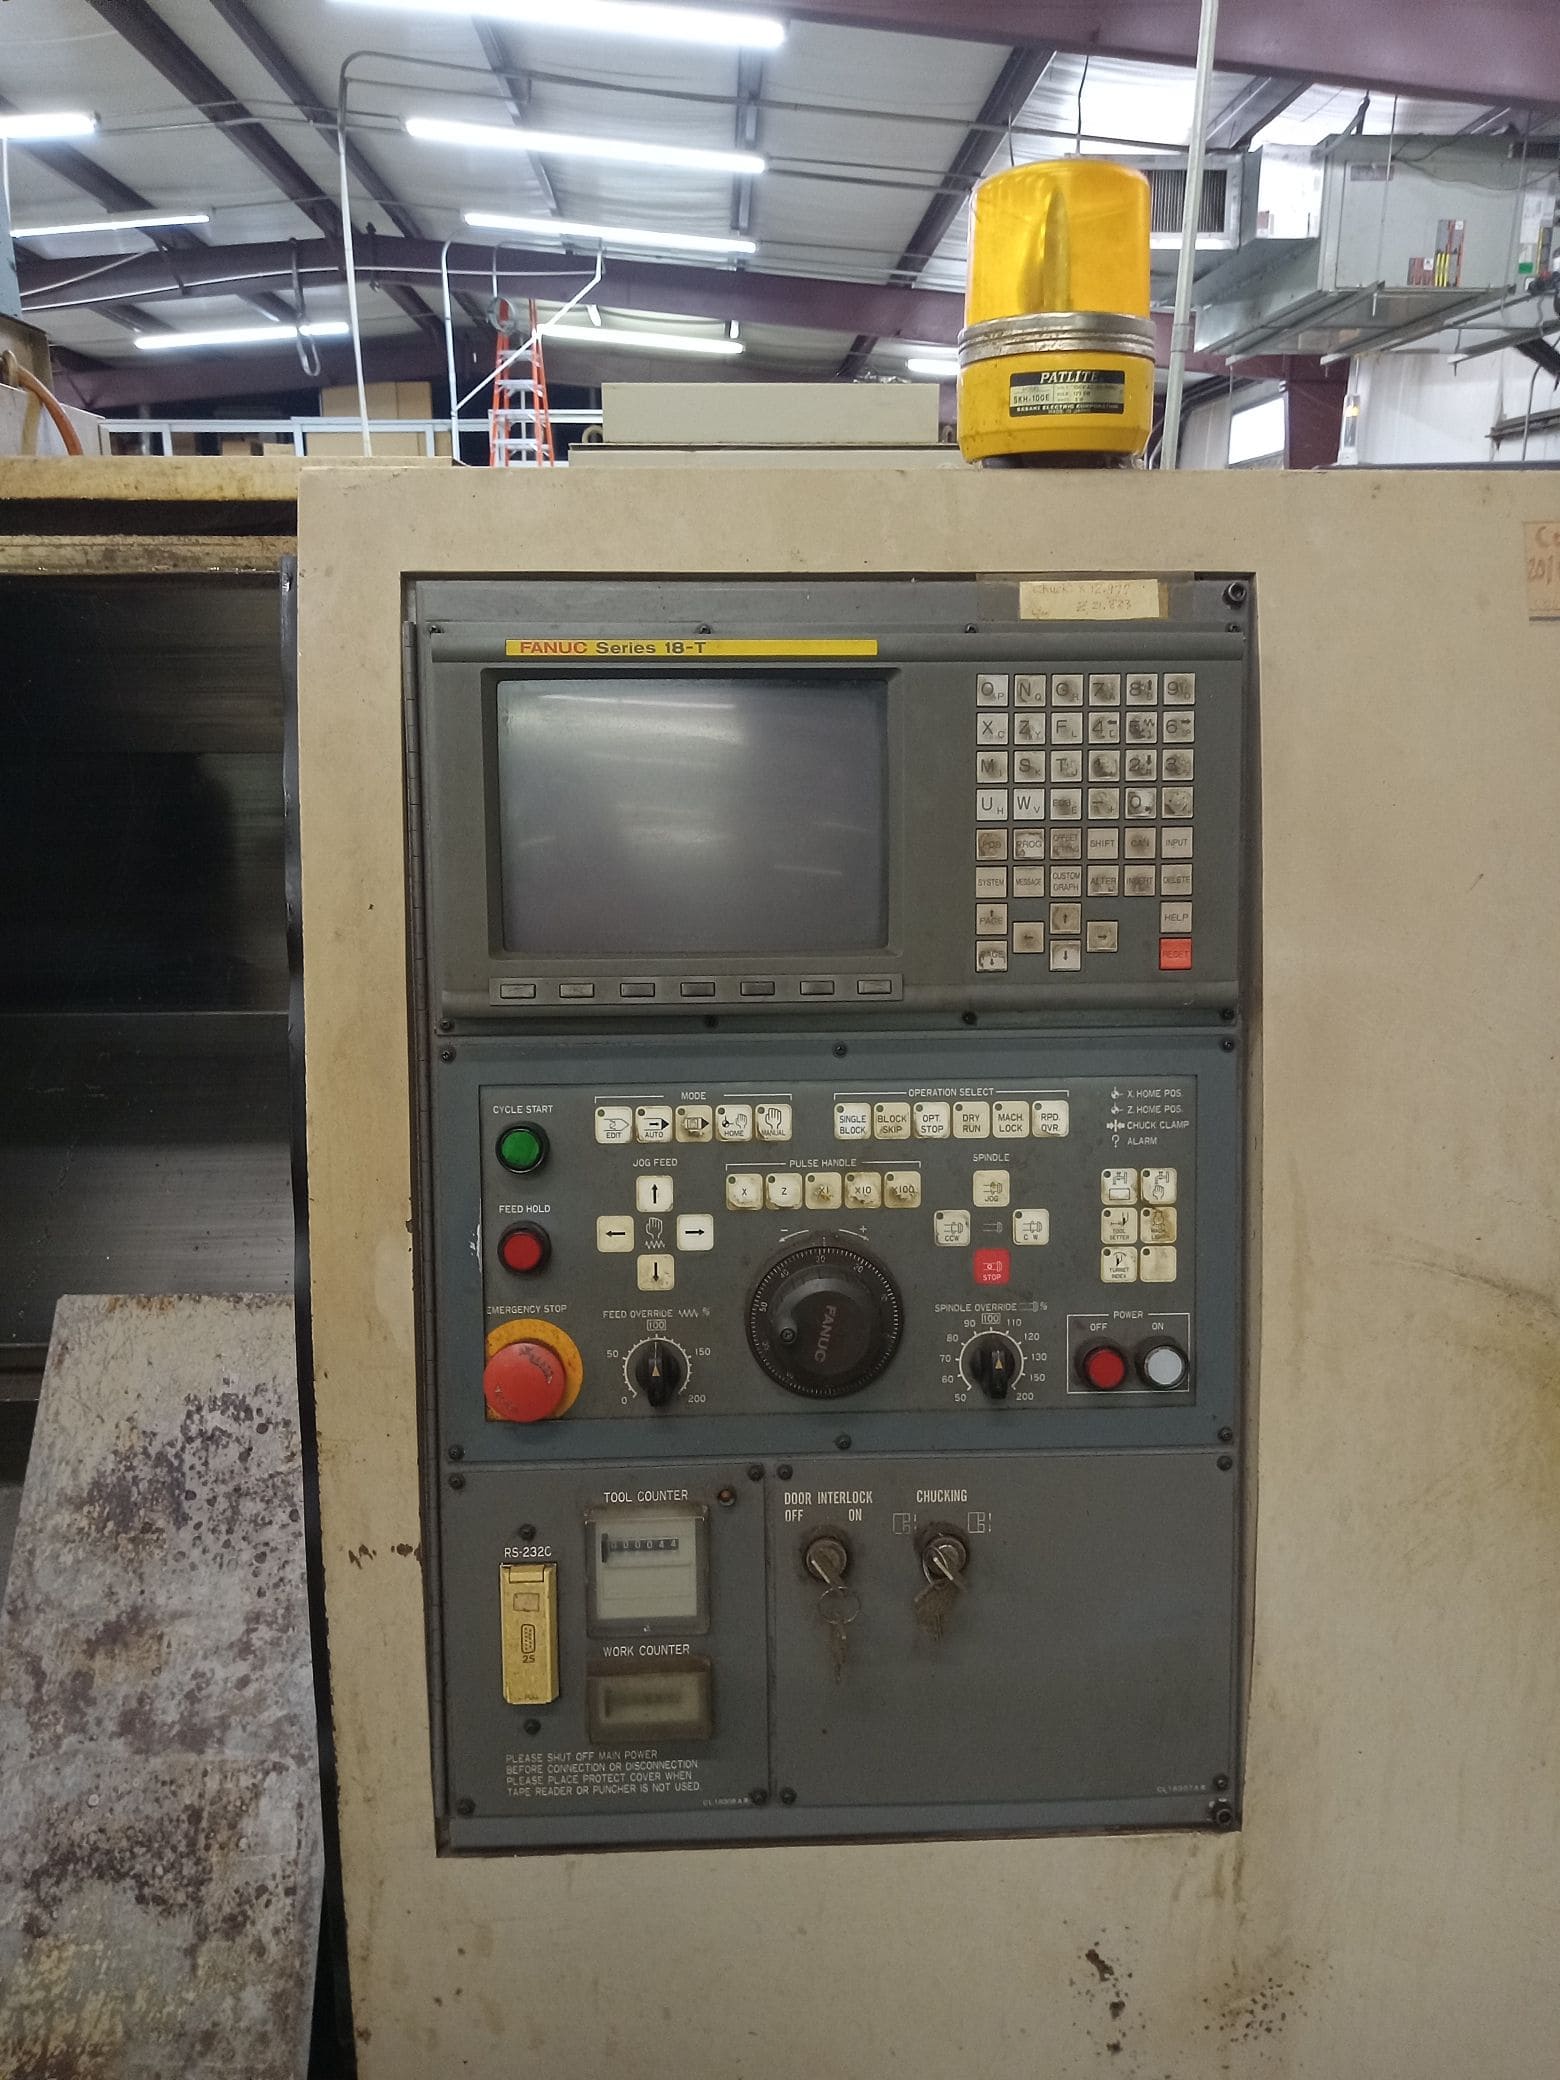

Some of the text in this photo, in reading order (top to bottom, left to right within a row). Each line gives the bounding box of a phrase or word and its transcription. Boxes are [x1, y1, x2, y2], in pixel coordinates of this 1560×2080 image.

[1040, 371, 1098, 383] PATLITE
[520, 641, 707, 654] FANUC Series 18-T
[1020, 682, 1031, 696] N
[1092, 682, 1104, 696] 7
[1129, 681, 1141, 696] 8
[1167, 681, 1178, 695] 9
[983, 721, 993, 735] X
[1020, 720, 1029, 734] Z
[1056, 720, 1067, 733] F
[1092, 720, 1103, 734] 4
[1166, 720, 1177, 733] 6
[1020, 758, 1030, 772] S
[1056, 758, 1067, 772] T
[982, 797, 992, 811] U
[1017, 796, 1031, 810] W
[1016, 840, 1042, 848] PROG
[1090, 840, 1115, 848] SHIFT
[1165, 838, 1188, 847] INPUT
[1052, 872, 1080, 880] CUSTOM
[1163, 876, 1190, 884] DELETE
[1090, 877, 1116, 885] ALTER
[681, 1091, 706, 1100] MODE
[908, 1088, 994, 1097] OPERATION SELECT
[1137, 1089, 1161, 1098] HOME
[493, 1105, 553, 1114] CYCLE START
[1137, 1105, 1161, 1113] HOME
[840, 1115, 866, 1124] SINGLE
[877, 1114, 907, 1123] BLOCK
[962, 1114, 980, 1122] DRY
[883, 1124, 902, 1133] SKIP
[921, 1124, 944, 1133] STOP
[963, 1124, 981, 1132] RUN
[1000, 1124, 1023, 1132] LOCK
[1127, 1121, 1189, 1129] CHUCK CLAMP
[840, 1126, 866, 1134] BLOCK
[1128, 1137, 1157, 1145] ALARM
[972, 1153, 1010, 1162] SPINDLE
[633, 1158, 678, 1167] JOG FEED
[789, 1159, 857, 1168] PULSE HANDLE
[741, 1188, 747, 1196] X
[782, 1187, 787, 1195] Z
[855, 1186, 871, 1194] X10
[499, 1204, 550, 1214] FEED HOLD
[487, 1304, 567, 1315] EMERGENCY STOP
[934, 1303, 1017, 1312] SPINDLE OVERRIDE
[602, 1309, 673, 1319] FEED OVERRIDE
[983, 1314, 999, 1323] 100
[1113, 1311, 1144, 1319] POWER
[648, 1321, 664, 1329] 100
[964, 1319, 976, 1328] 90
[1007, 1319, 1022, 1327] 110
[1090, 1323, 1108, 1331] OFF
[1152, 1322, 1164, 1331] ON
[814, 1305, 838, 1363] FANUC
[947, 1334, 959, 1342] 80
[1024, 1333, 1040, 1341] 120
[606, 1350, 619, 1358] 50
[695, 1348, 711, 1356] 150
[939, 1355, 951, 1363] 70
[1031, 1353, 1047, 1361] 130
[942, 1375, 954, 1384] 60
[1029, 1374, 1046, 1382] 150
[621, 1397, 627, 1405] 0
[688, 1395, 706, 1403] 200
[954, 1394, 966, 1402] 50
[1016, 1392, 1034, 1401] 200
[604, 1490, 688, 1503] TOOL COUNTER
[784, 1491, 873, 1505] DOOR INTERLOCK
[916, 1490, 968, 1502] CHUCKING
[785, 1510, 803, 1522] OFF
[849, 1508, 862, 1521] ON
[504, 1546, 552, 1558] RS-232C
[603, 1644, 690, 1657] WORK COUNTER
[522, 1655, 535, 1663] 25
[506, 1750, 657, 1763] PLEASE SHUT OFF MAIN POWER
[506, 1765, 543, 1774] BEFORE
[548, 1763, 605, 1773] CONNECTION
[609, 1762, 622, 1771] OR
[506, 1771, 692, 1785] PLEASE PLACE PROTECT COVER WHEN
[507, 1787, 532, 1797] TAPE
[536, 1786, 572, 1795] READER
[576, 1785, 589, 1794] OR
[593, 1784, 636, 1794] PUNCHER
[640, 1784, 649, 1792] IS
[652, 1783, 672, 1792] NOT
